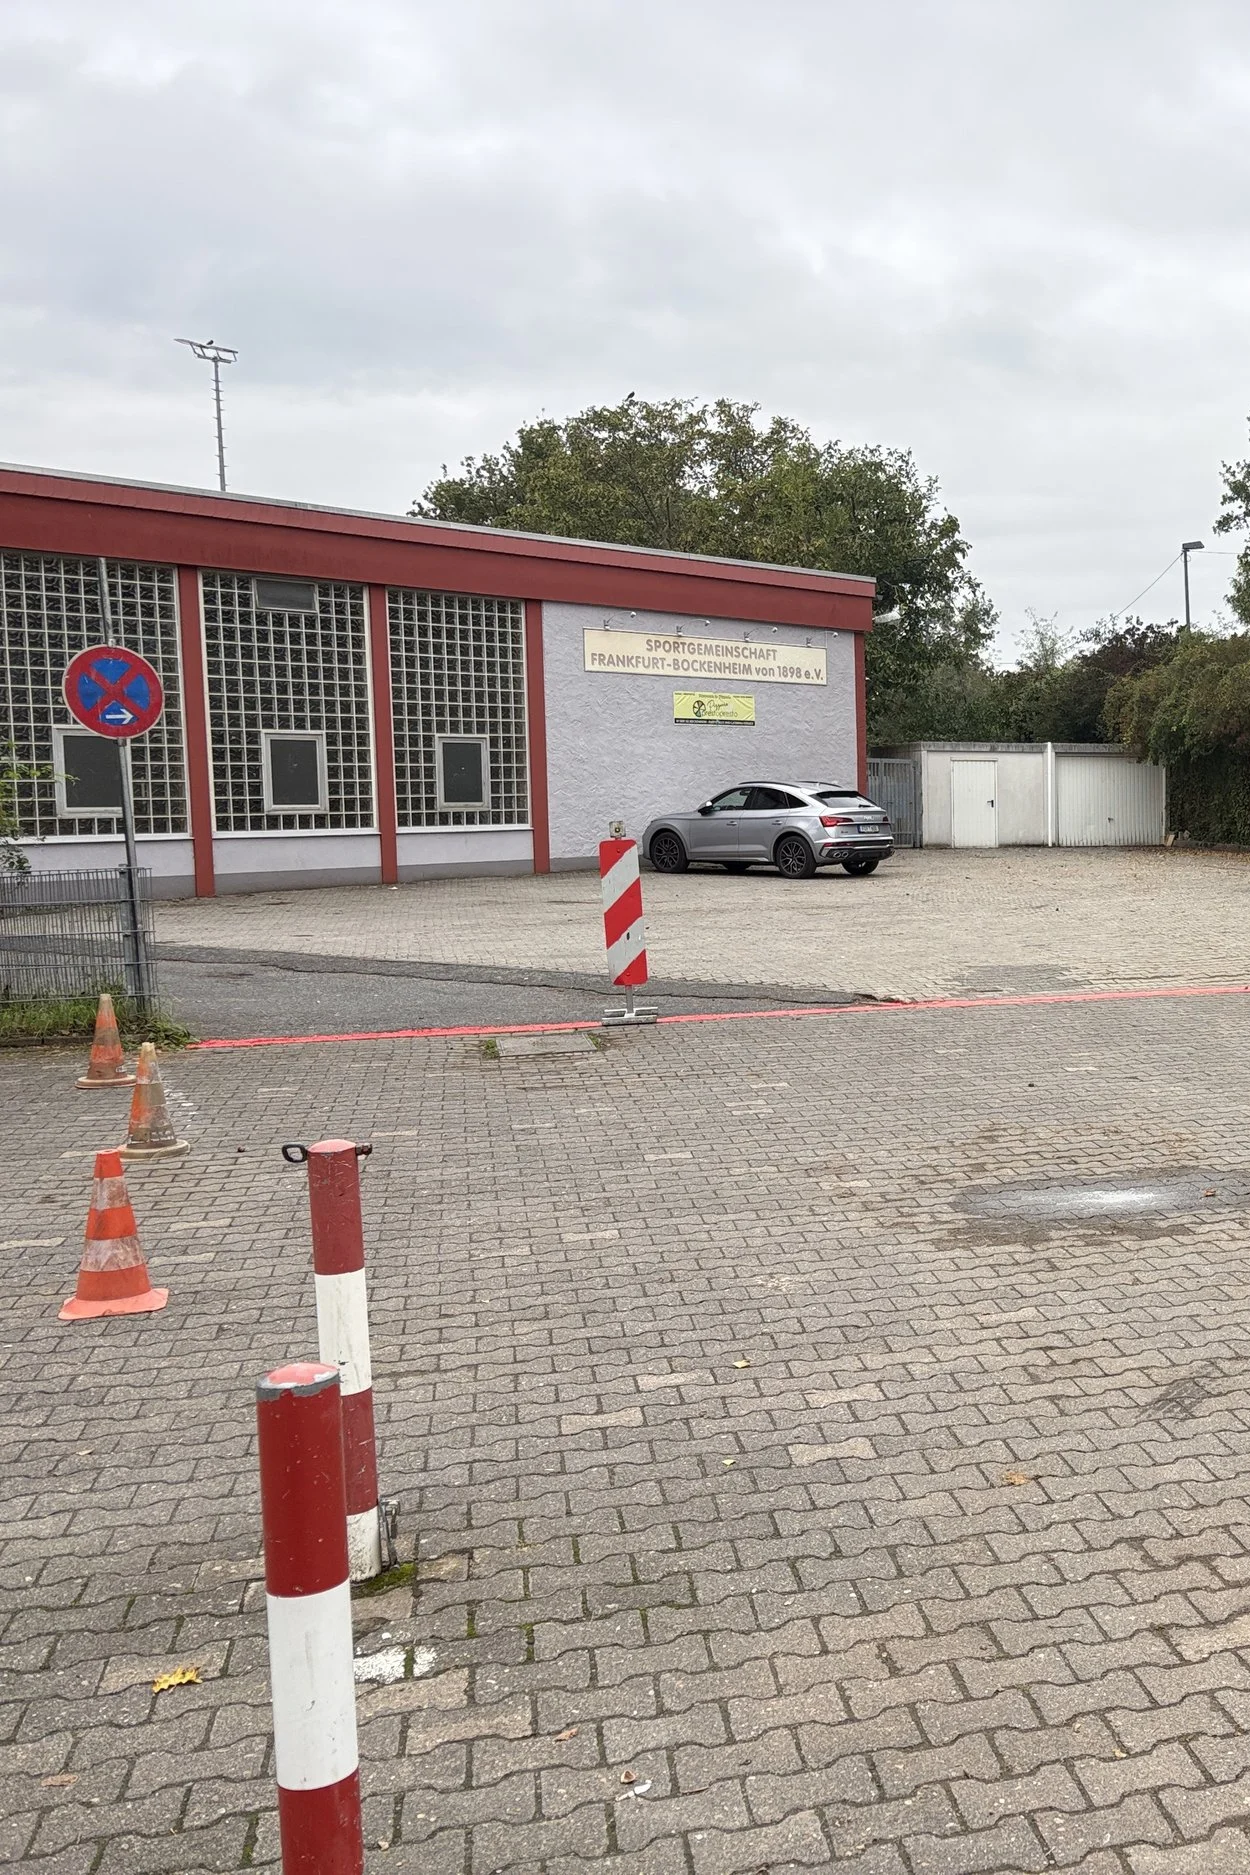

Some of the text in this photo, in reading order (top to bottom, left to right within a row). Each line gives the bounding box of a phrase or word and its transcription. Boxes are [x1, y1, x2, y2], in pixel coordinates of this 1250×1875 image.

[646, 639, 777, 660] SPORTGEMEINSCHAFT
[591, 653, 824, 681] FRANKFURT-BOCKENHEIM von 1898 e.V.
